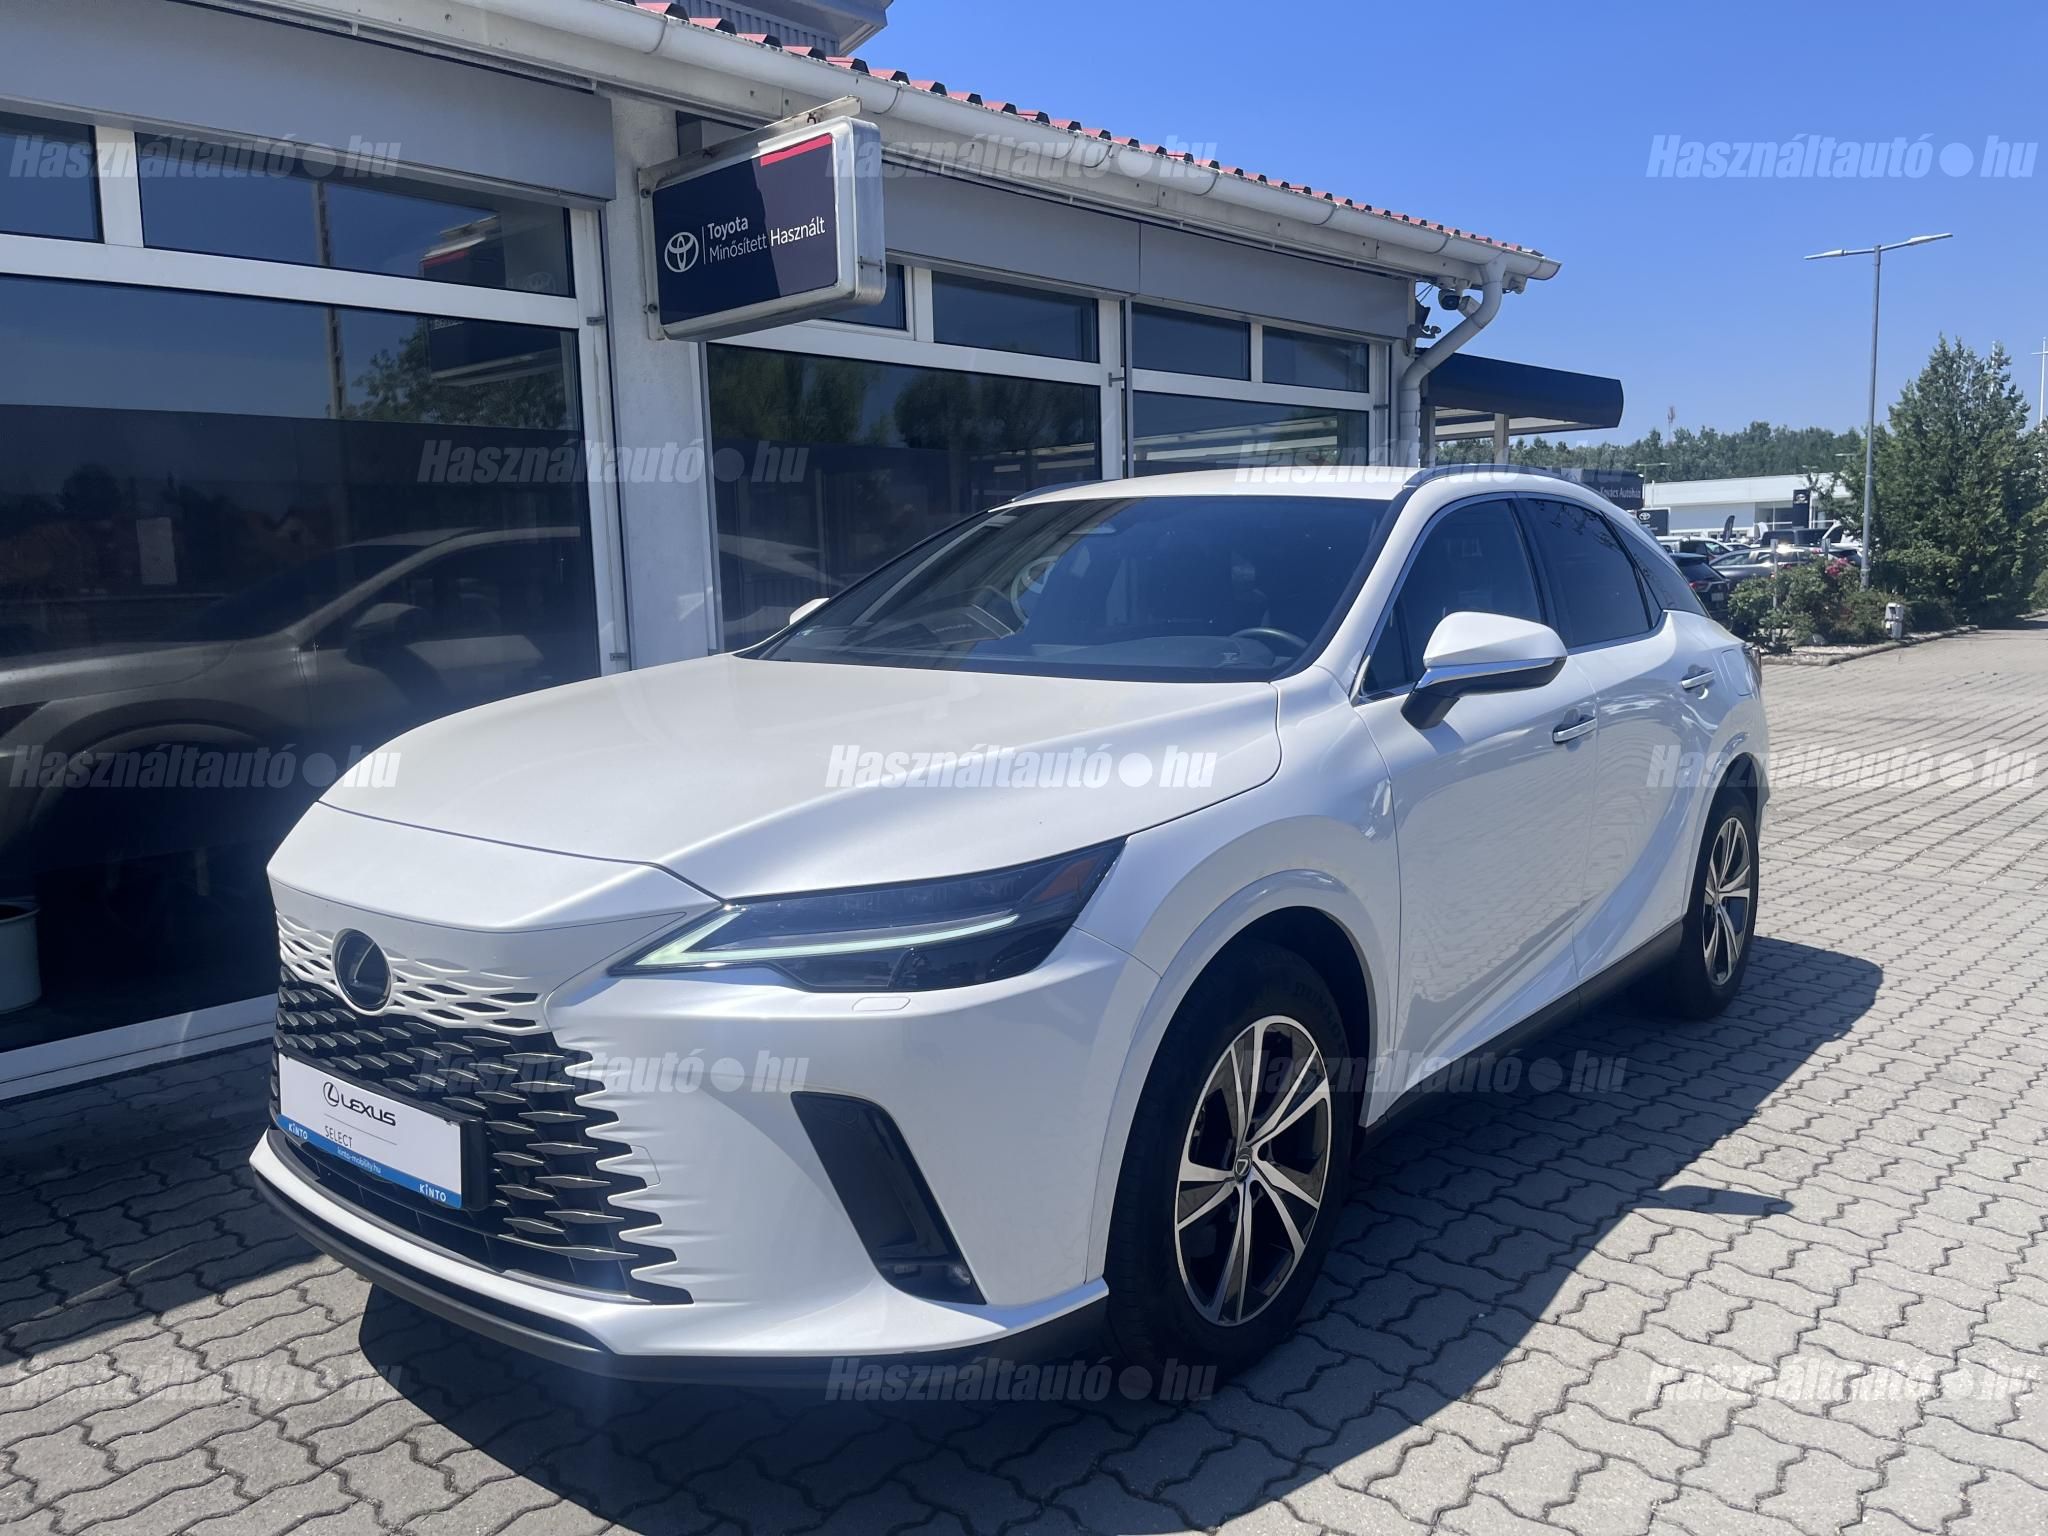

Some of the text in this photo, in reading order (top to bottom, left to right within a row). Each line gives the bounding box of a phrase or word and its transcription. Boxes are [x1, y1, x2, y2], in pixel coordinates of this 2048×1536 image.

[707, 216, 749, 241] Toyota
[709, 216, 826, 264] Minősített Használt
[341, 1094, 396, 1126] LEXUS
[324, 1125, 353, 1148] SELECT
